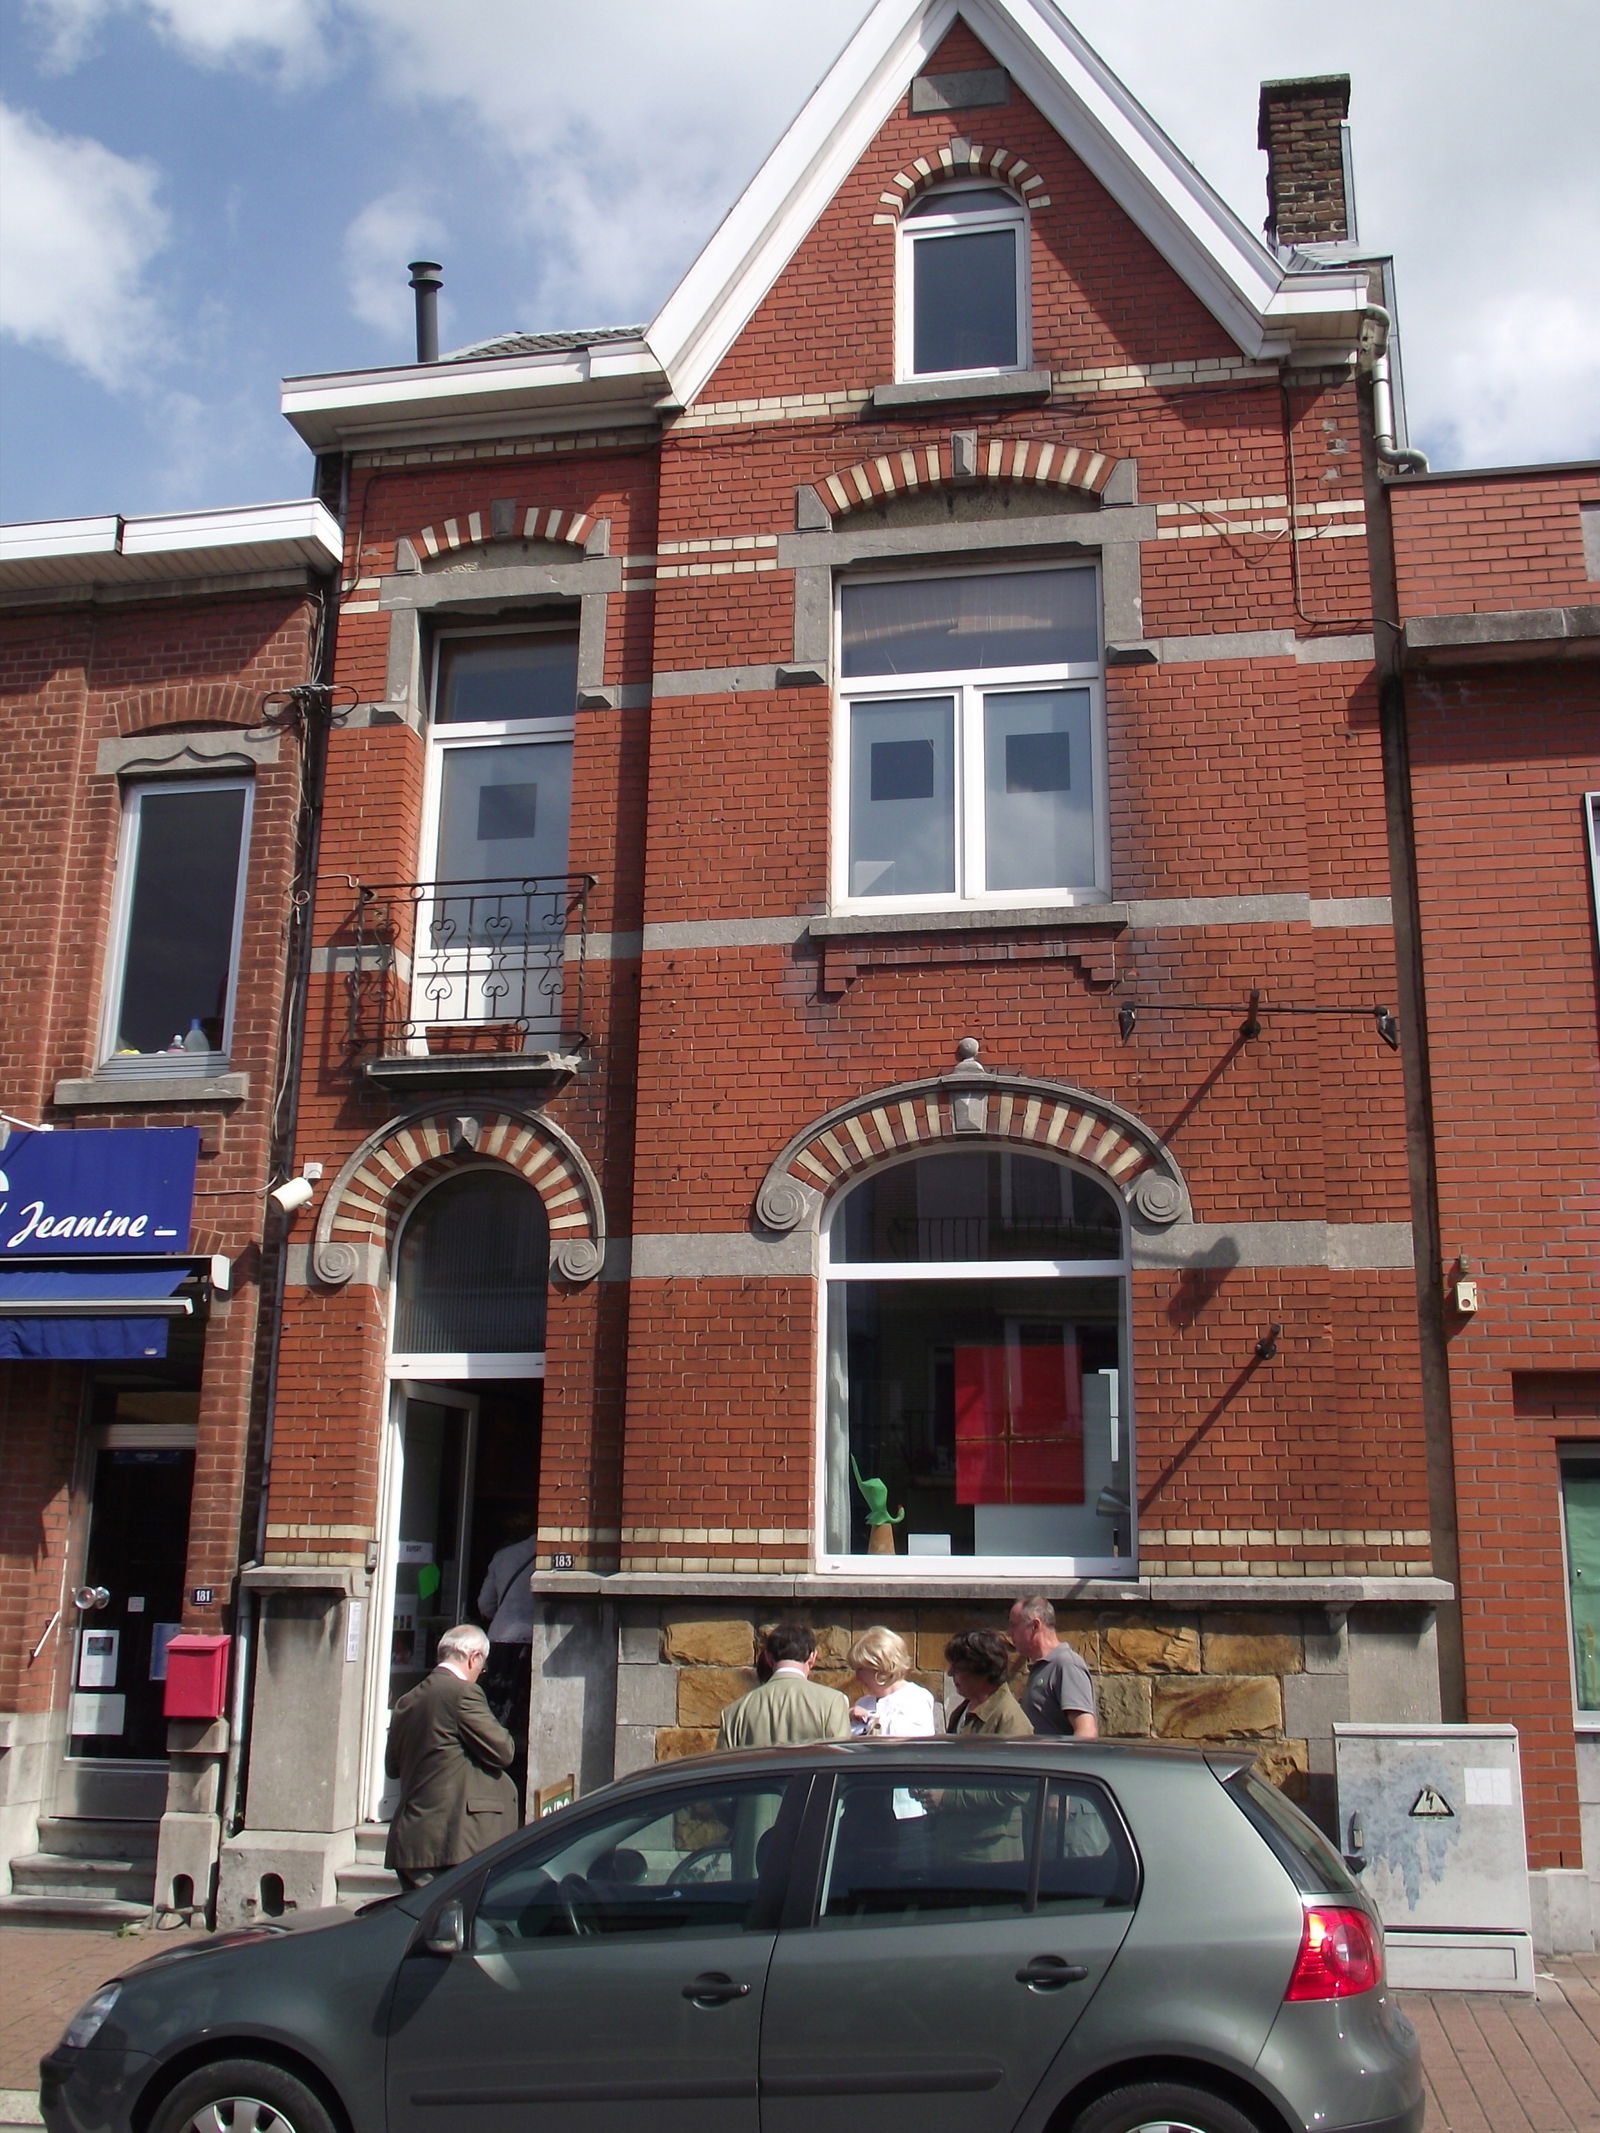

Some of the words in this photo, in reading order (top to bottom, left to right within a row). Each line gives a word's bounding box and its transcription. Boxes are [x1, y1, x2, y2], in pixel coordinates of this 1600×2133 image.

[7, 1200, 149, 1248] Jeanine
[555, 1554, 572, 1568] 183
[195, 1590, 211, 1602] 181
